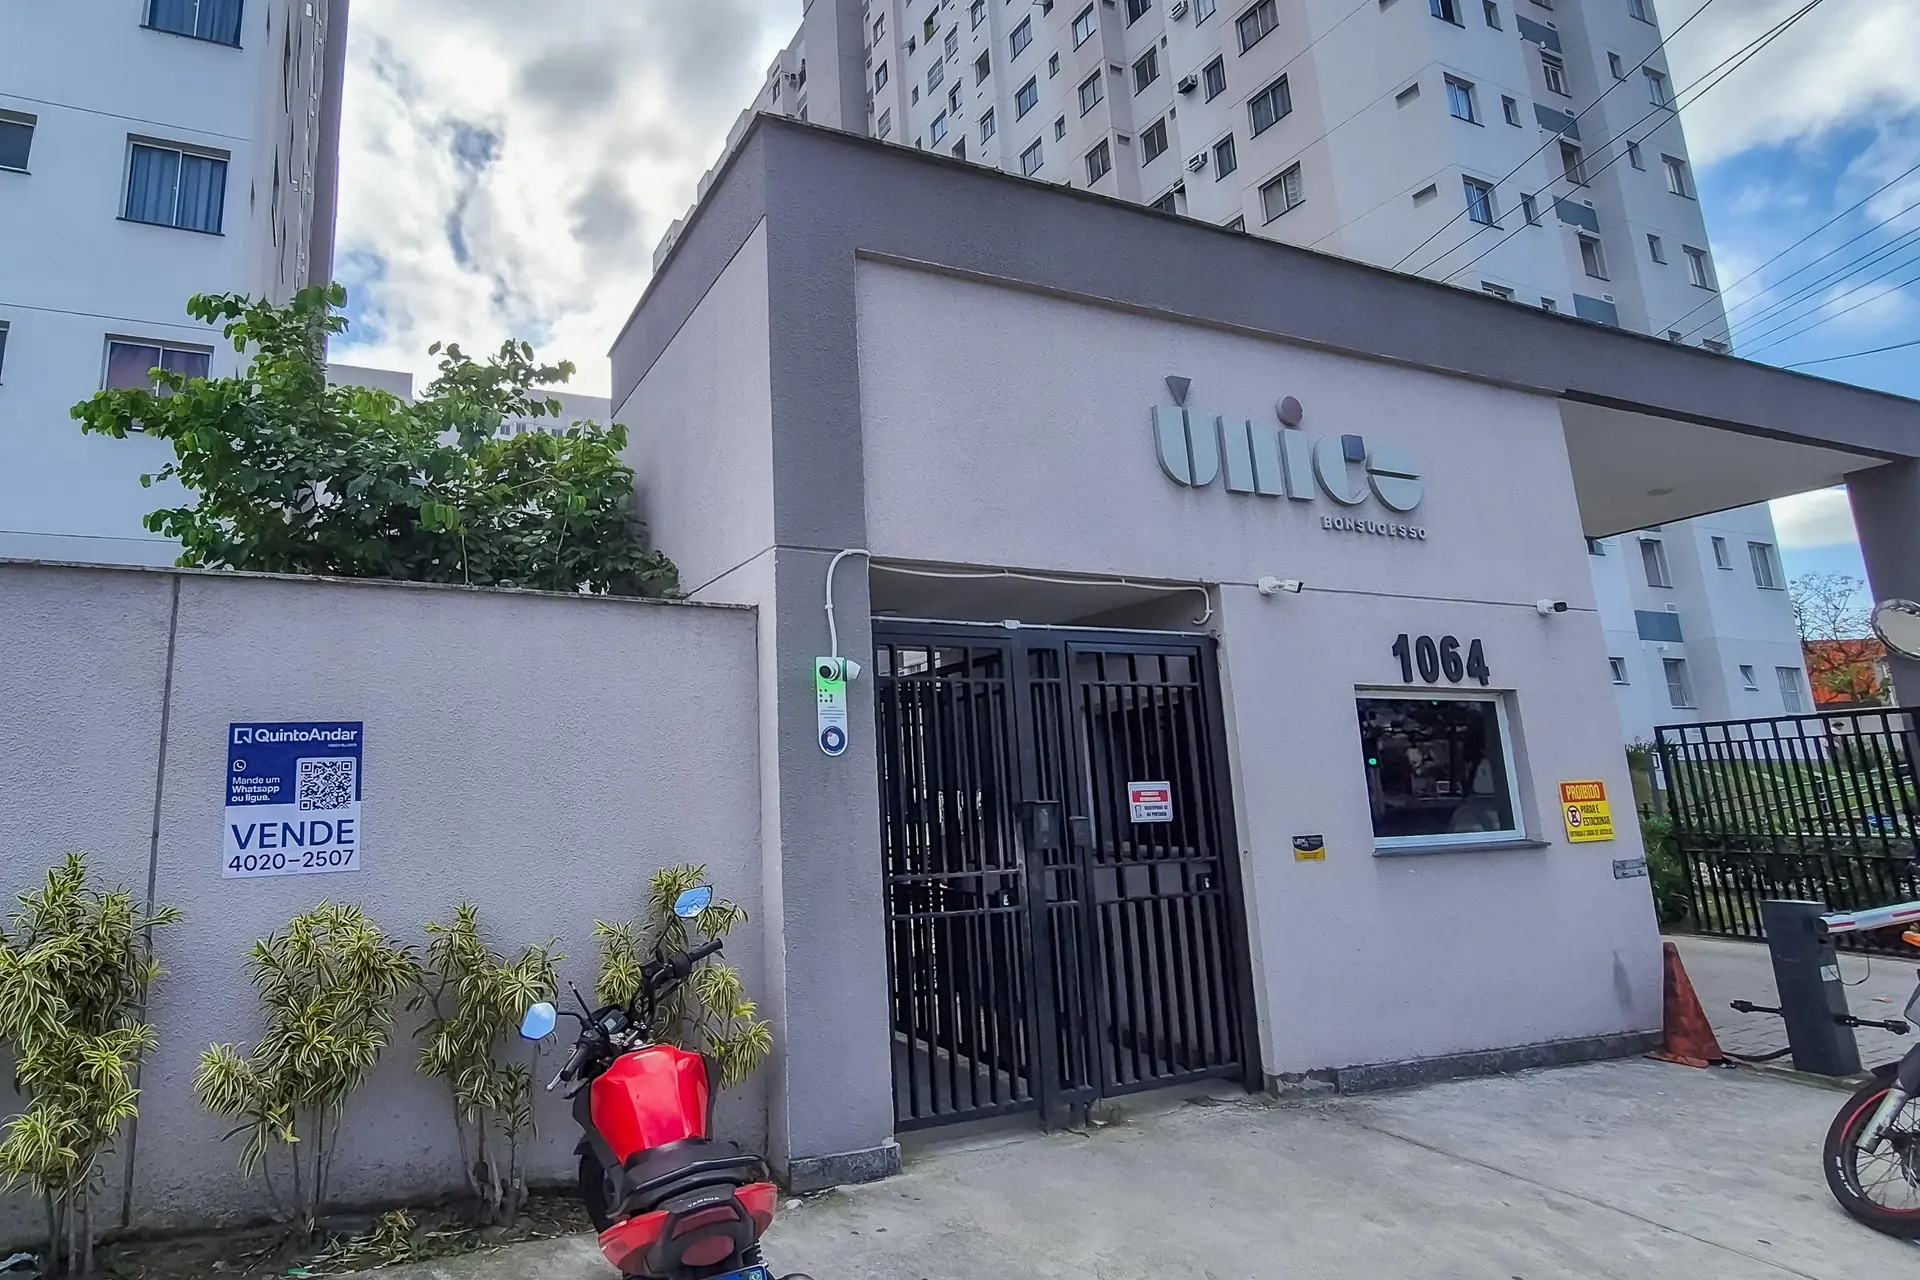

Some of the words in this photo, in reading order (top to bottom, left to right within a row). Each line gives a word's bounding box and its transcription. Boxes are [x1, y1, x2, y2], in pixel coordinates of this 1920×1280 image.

[1321, 516, 1427, 540] BONSUCESSO
[1392, 633, 1490, 686] 1064
[255, 728, 358, 743] QuintoAndar
[232, 776, 264, 785] Mande
[265, 776, 280, 784] um
[231, 785, 280, 794] Whatsapp
[1565, 784, 1600, 800] PROIBIDO
[245, 794, 270, 803] ligue.
[231, 819, 355, 850] VENDE
[228, 850, 354, 872] 4020-2507
